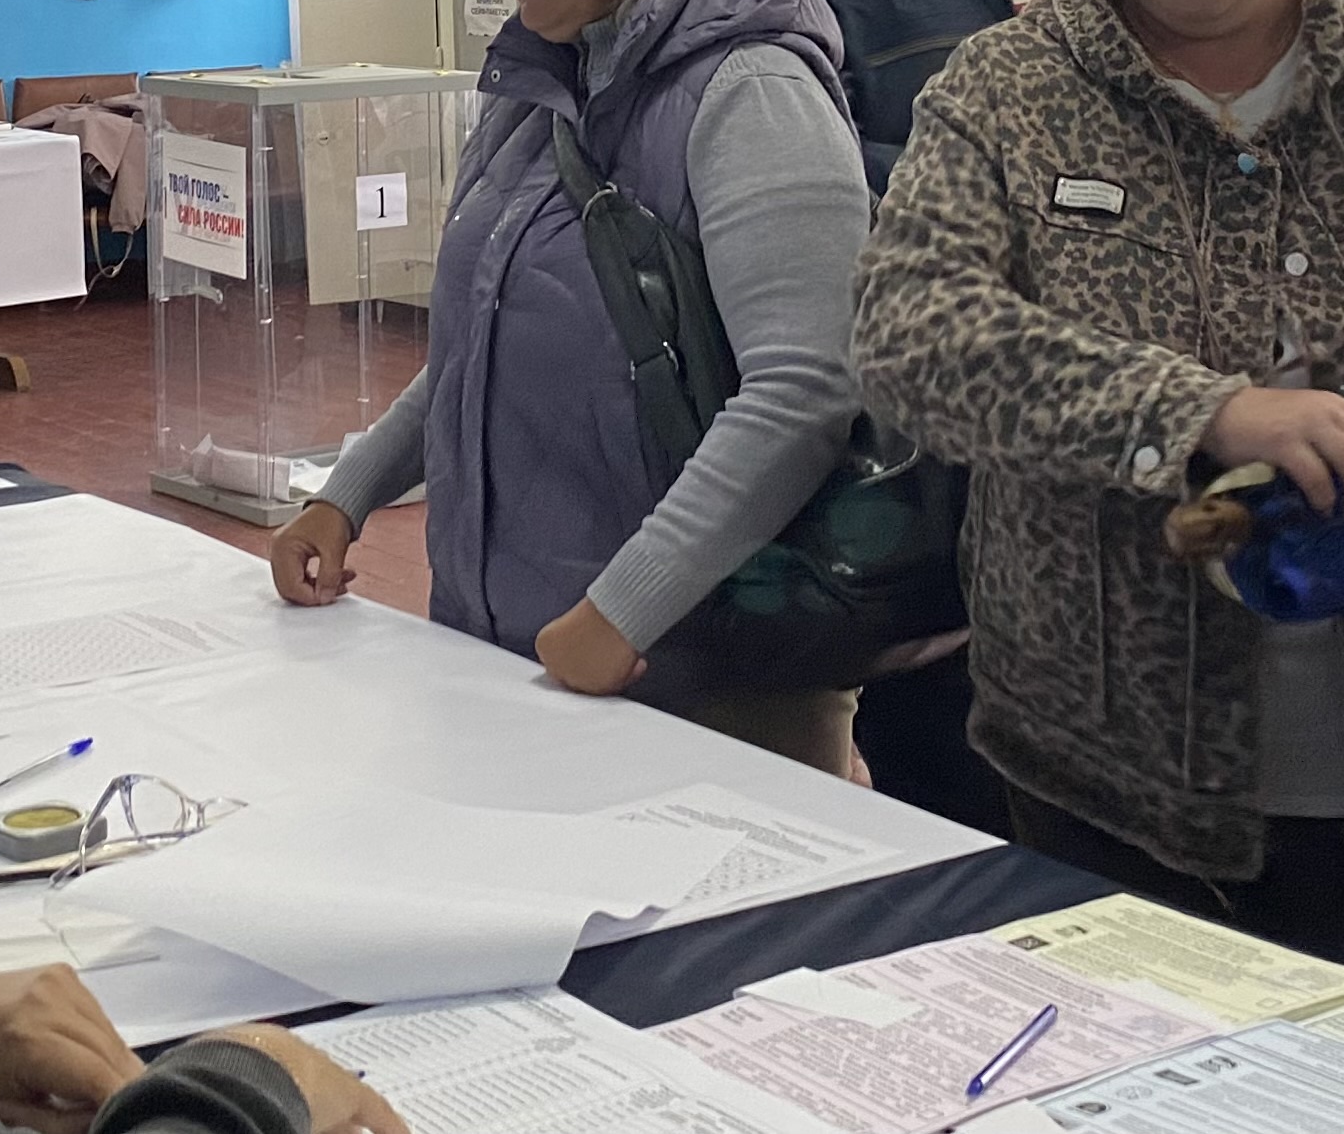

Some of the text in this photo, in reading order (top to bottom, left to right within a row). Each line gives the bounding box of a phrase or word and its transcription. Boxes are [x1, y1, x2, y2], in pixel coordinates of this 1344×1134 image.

[168, 172, 190, 197] ТВОЙ
[191, 177, 221, 204] ГОЛОС
[375, 185, 388, 219] 1
[177, 204, 245, 240] СИЛА РОССИИ!
